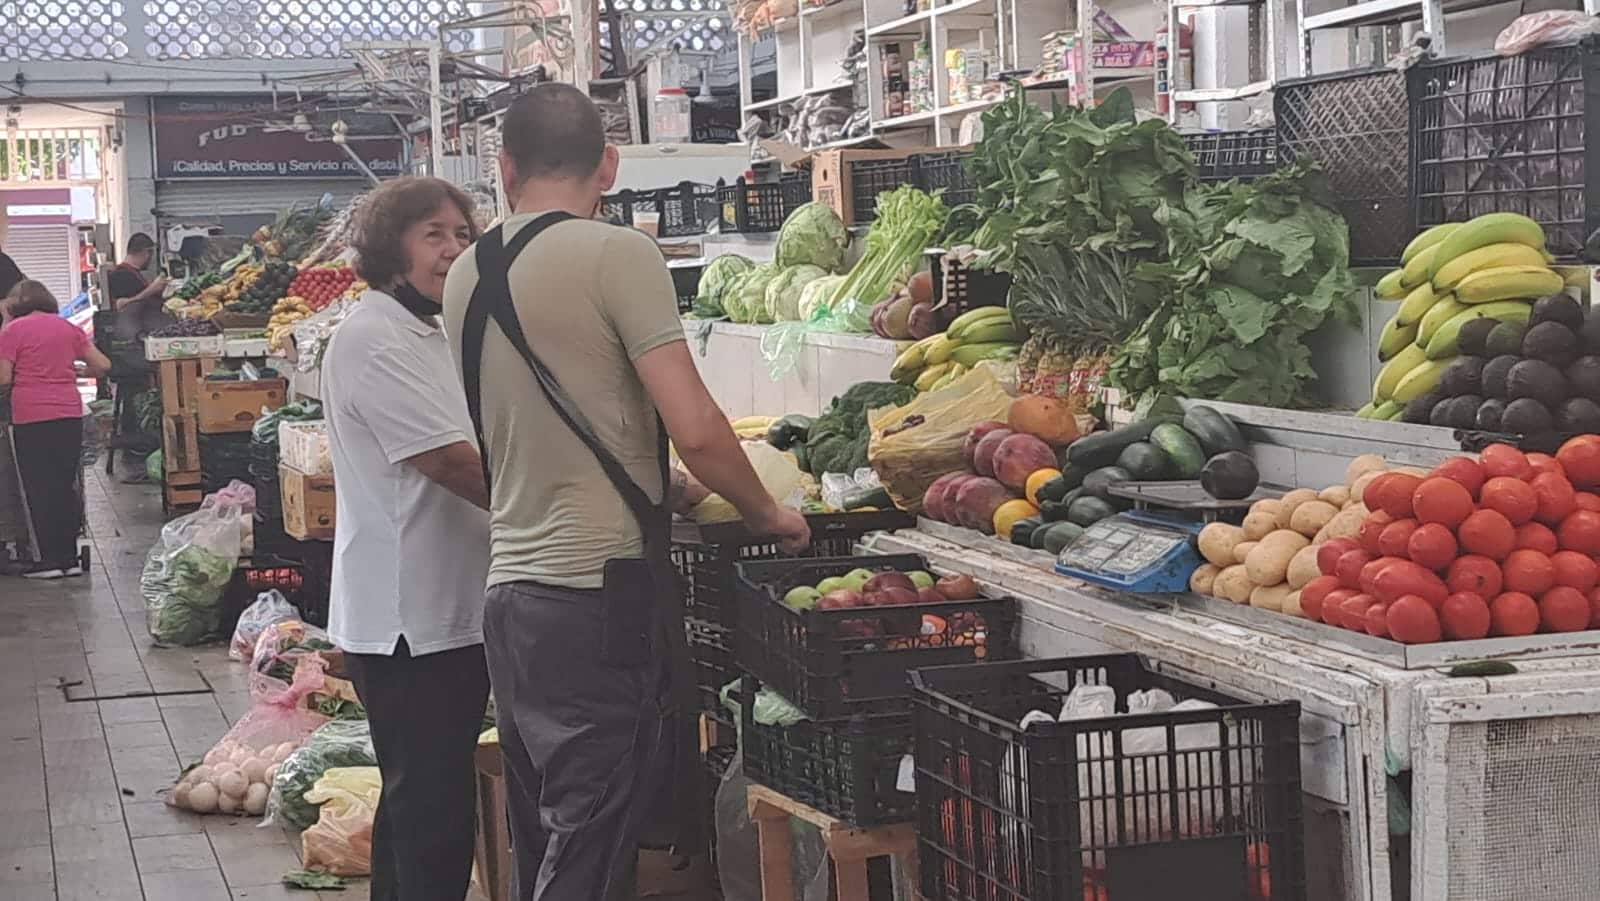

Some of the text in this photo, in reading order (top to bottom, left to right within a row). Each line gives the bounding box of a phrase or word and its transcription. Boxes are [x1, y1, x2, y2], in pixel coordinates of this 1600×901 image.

[198, 124, 246, 147] FUD
[229, 160, 275, 171] Precios
[278, 162, 287, 174] y
[289, 160, 339, 171] Servicio
